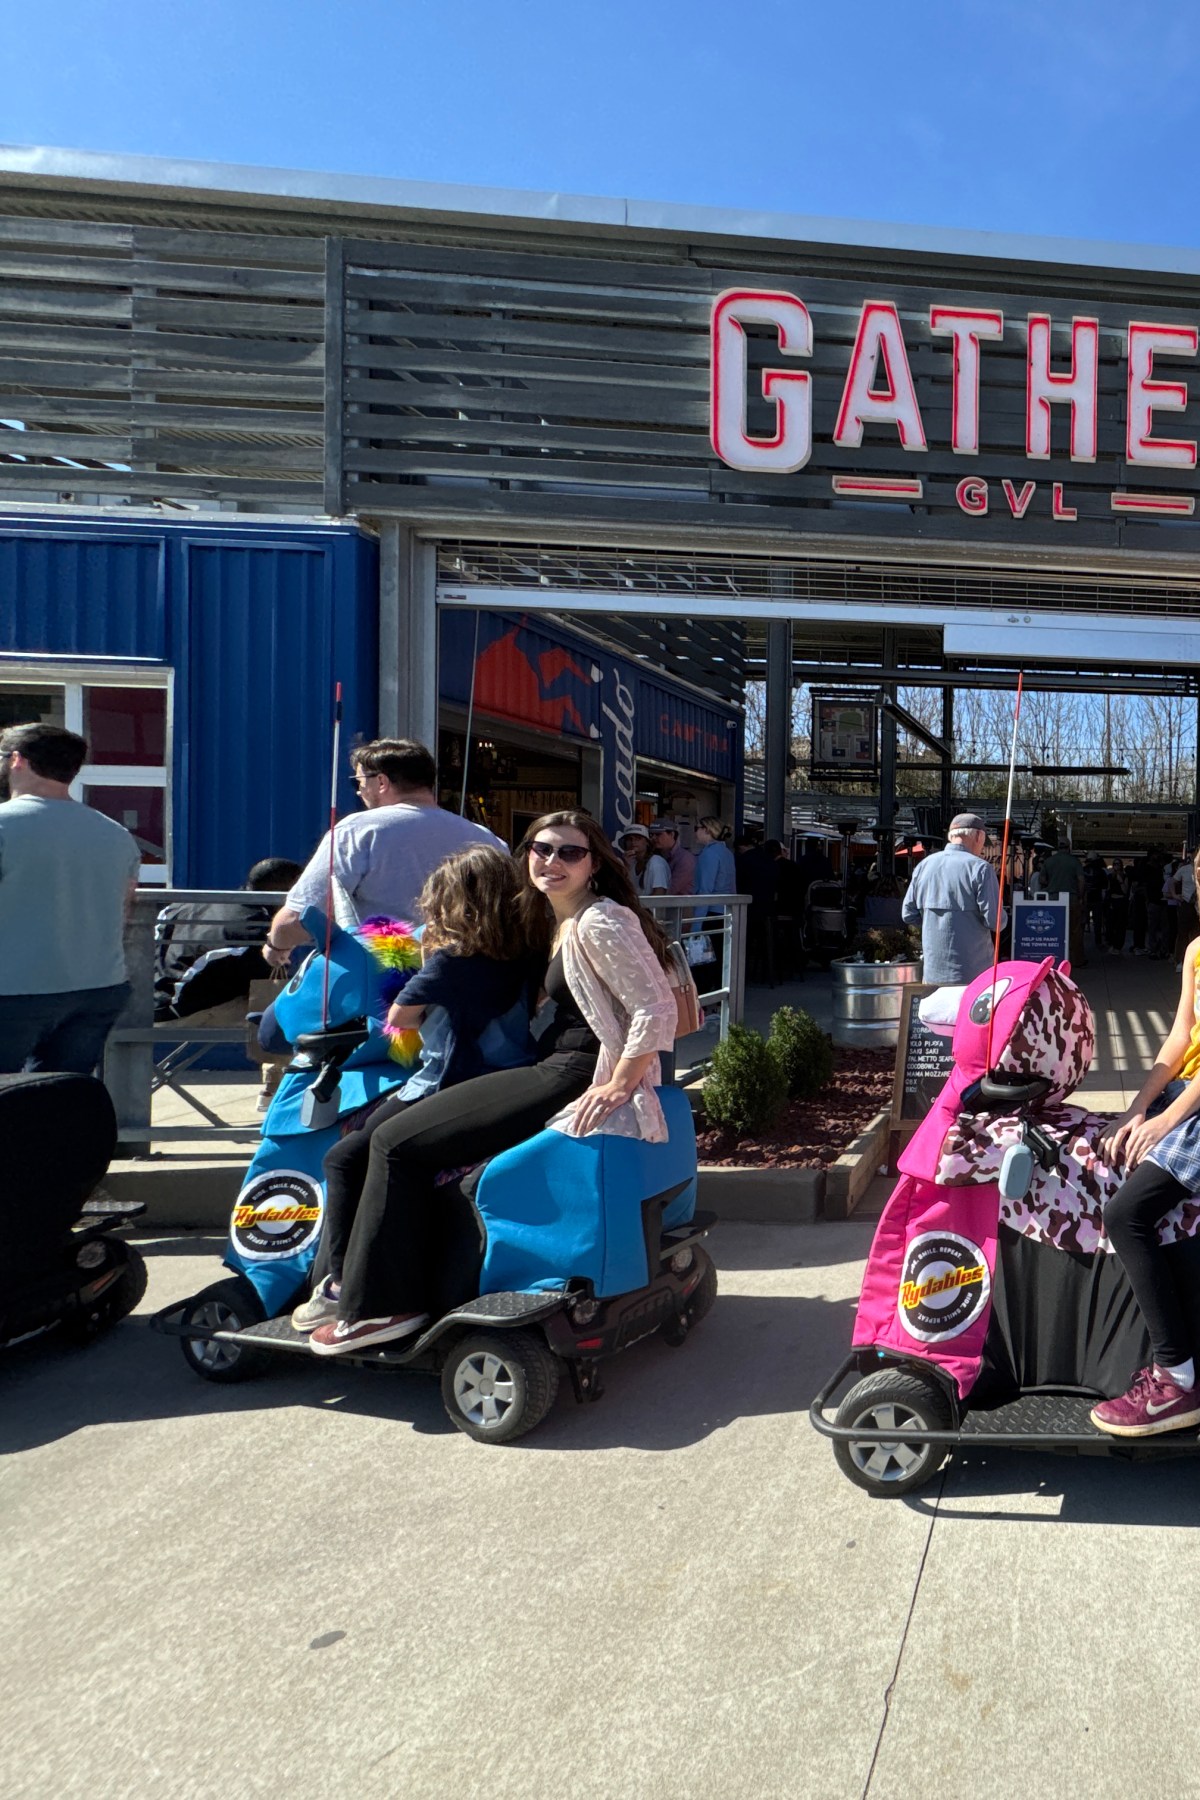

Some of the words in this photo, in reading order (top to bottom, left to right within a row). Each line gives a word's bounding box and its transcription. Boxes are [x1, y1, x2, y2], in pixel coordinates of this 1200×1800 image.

[954, 475, 1079, 522] GVL
[601, 667, 635, 852] rcado
[924, 1070, 952, 1078] MOZZARE
[232, 1204, 321, 1229] Rydables
[939, 1246, 962, 1260] REPEAT.
[901, 1265, 985, 1310] Rydables
